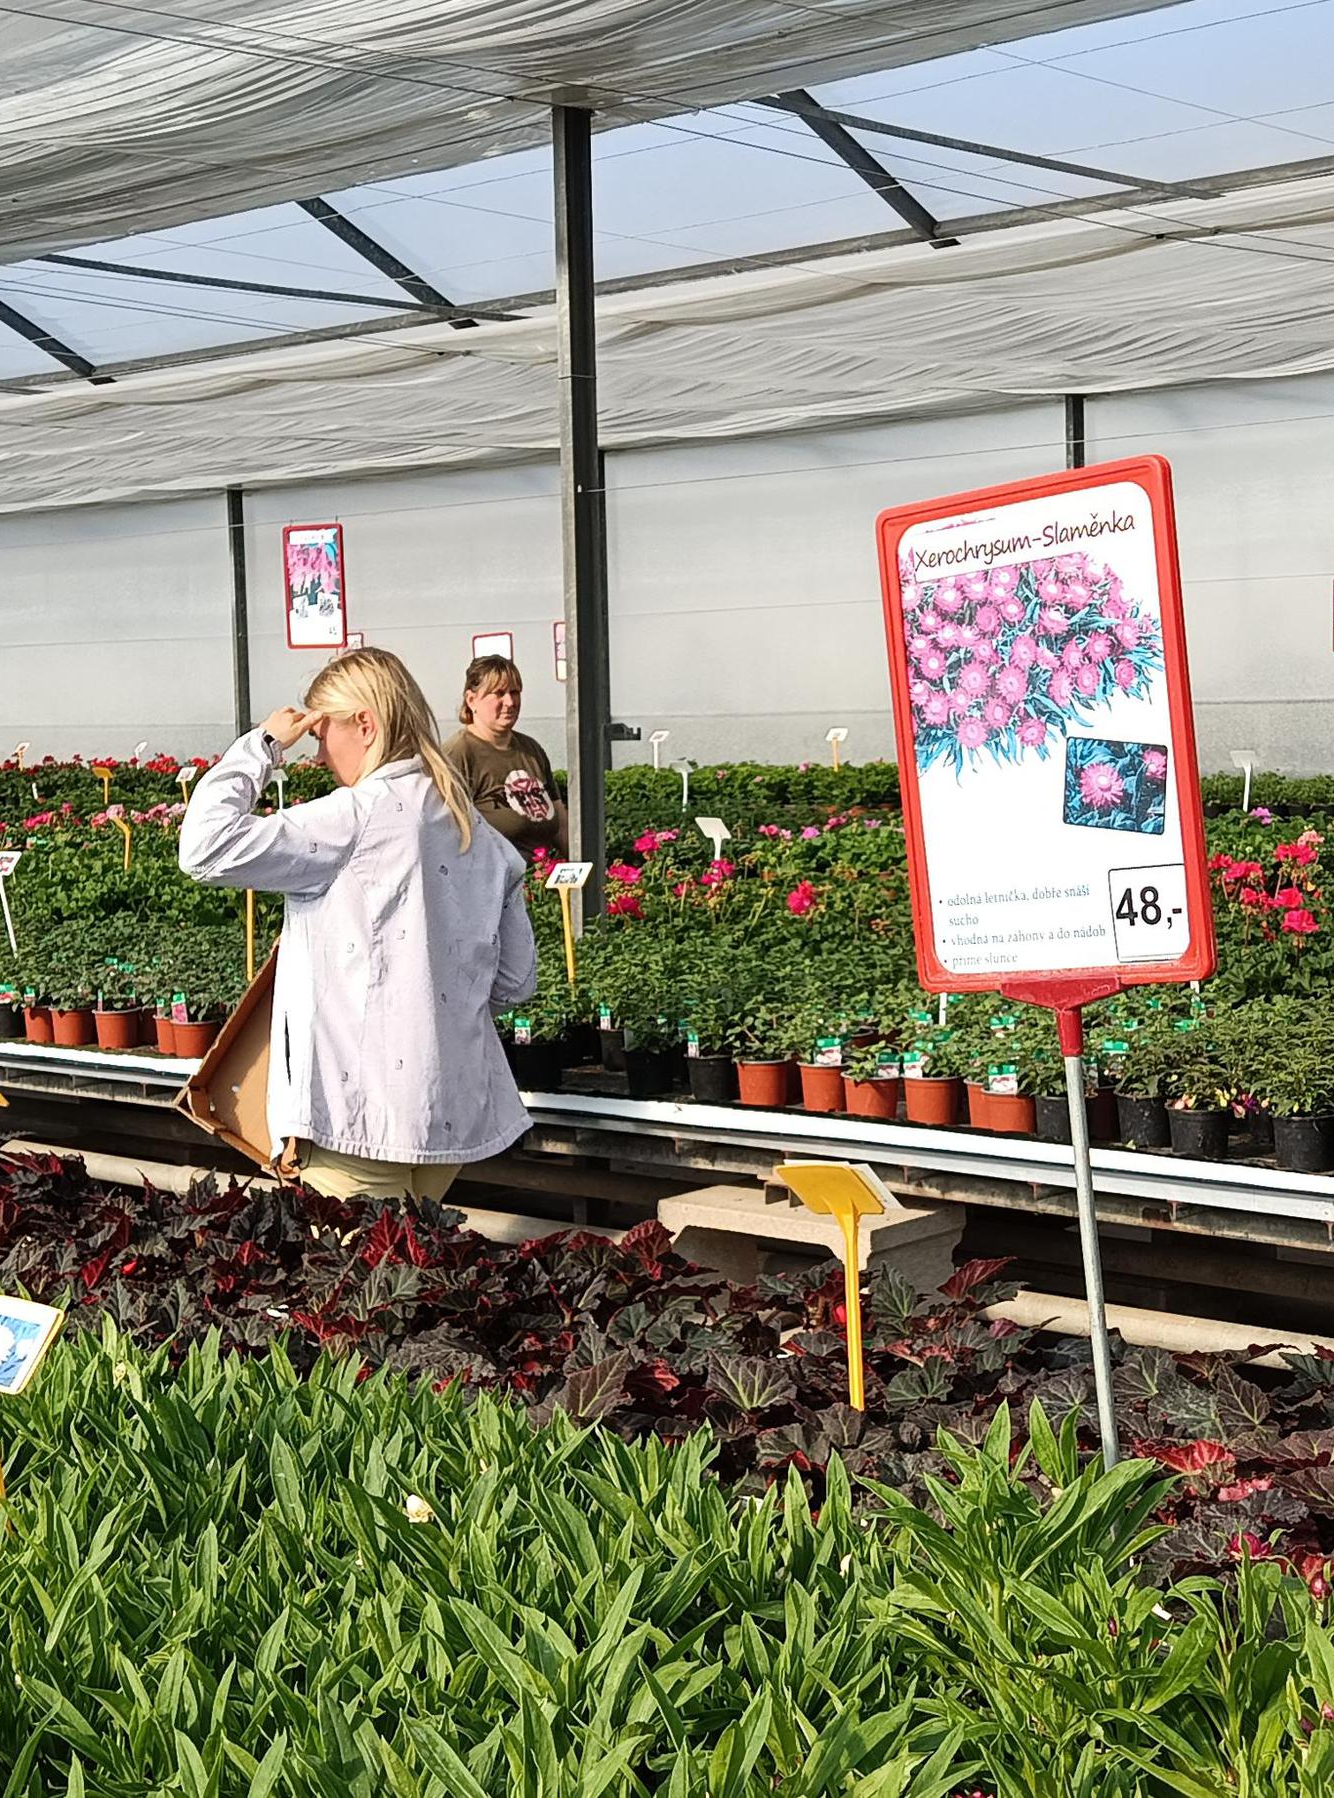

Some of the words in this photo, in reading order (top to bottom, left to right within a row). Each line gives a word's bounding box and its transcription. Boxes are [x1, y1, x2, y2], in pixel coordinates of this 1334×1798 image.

[915, 510, 1135, 571] Xerochrysum-Slaměnka
[949, 913, 979, 927] sucho
[1116, 886, 1182, 929] 48,-
[992, 935, 1004, 945] na
[1057, 927, 1071, 940] do
